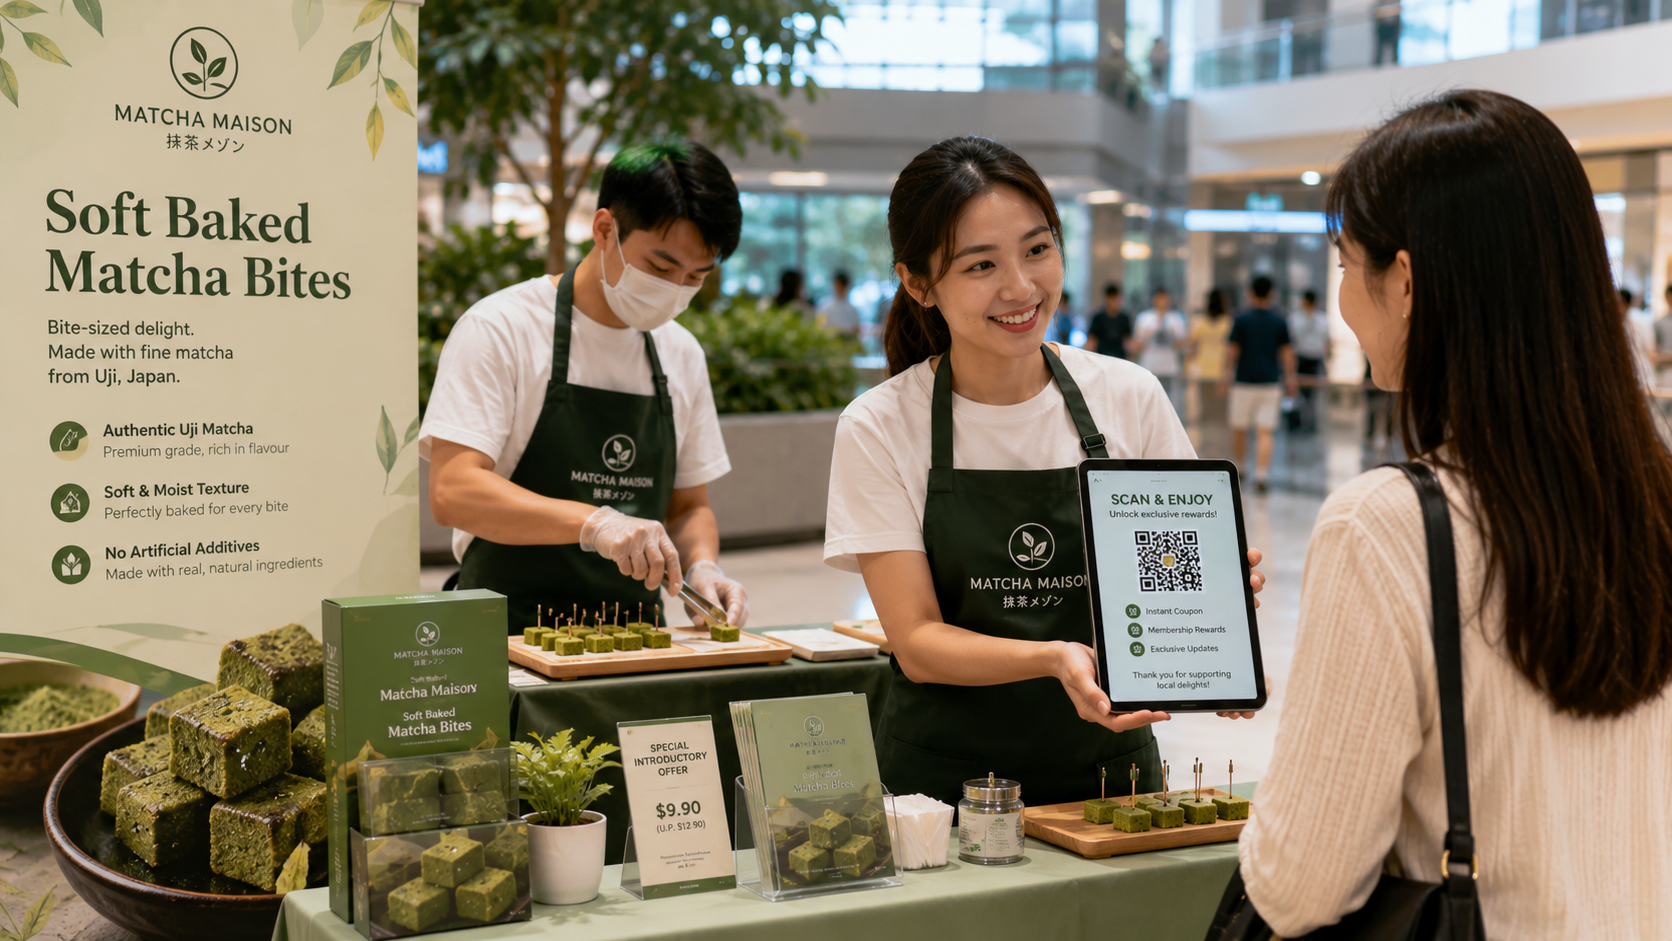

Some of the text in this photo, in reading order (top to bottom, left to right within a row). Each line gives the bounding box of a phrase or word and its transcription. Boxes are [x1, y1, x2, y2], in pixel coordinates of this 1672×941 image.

[115, 103, 292, 135] MATCHA MAISON
[167, 133, 245, 153] 抹茶メゾン
[46, 188, 312, 244] Soft Baked
[45, 249, 352, 300] Matcha Bites
[48, 319, 194, 339] Bite-sized delight.
[48, 344, 233, 360] Made with fine matcha
[48, 369, 180, 387] from Uji, Japan.
[103, 421, 253, 438] Authentic Uji Matcha
[103, 442, 289, 459] Premium grade, rich in flavour
[571, 470, 653, 487] MATCHA MAISON
[104, 481, 249, 499] Soft & Moist Texture
[1111, 494, 1213, 505] SCAN & ENJOY
[104, 501, 289, 520] Perfectly baked for every bite
[1141, 510, 1179, 518] exclusive
[1182, 510, 1218, 518] rewards!
[105, 540, 260, 560] No Artificial Additives
[105, 556, 323, 581] Made with real, natural ingredients
[970, 577, 1032, 590] MATCHA
[1003, 595, 1063, 608] 抹茶メゾン
[1174, 608, 1203, 616] Coupon
[1148, 626, 1193, 635] Membership
[394, 650, 429, 659] MATCHA
[1150, 644, 1218, 654] Exclusive Updates
[1159, 673, 1174, 681] you
[1175, 671, 1186, 679] for
[1188, 671, 1231, 679] supporting
[1177, 681, 1210, 690] delights!
[381, 687, 427, 701] Matcha
[403, 711, 422, 721] Soft
[388, 720, 472, 738] Matcha Bites
[650, 741, 689, 753] SPECIAL
[634, 752, 707, 766] INTRODUCTORY
[658, 766, 688, 776] OFFER
[656, 800, 701, 820] $9.90
[656, 824, 676, 834] (U.P.
